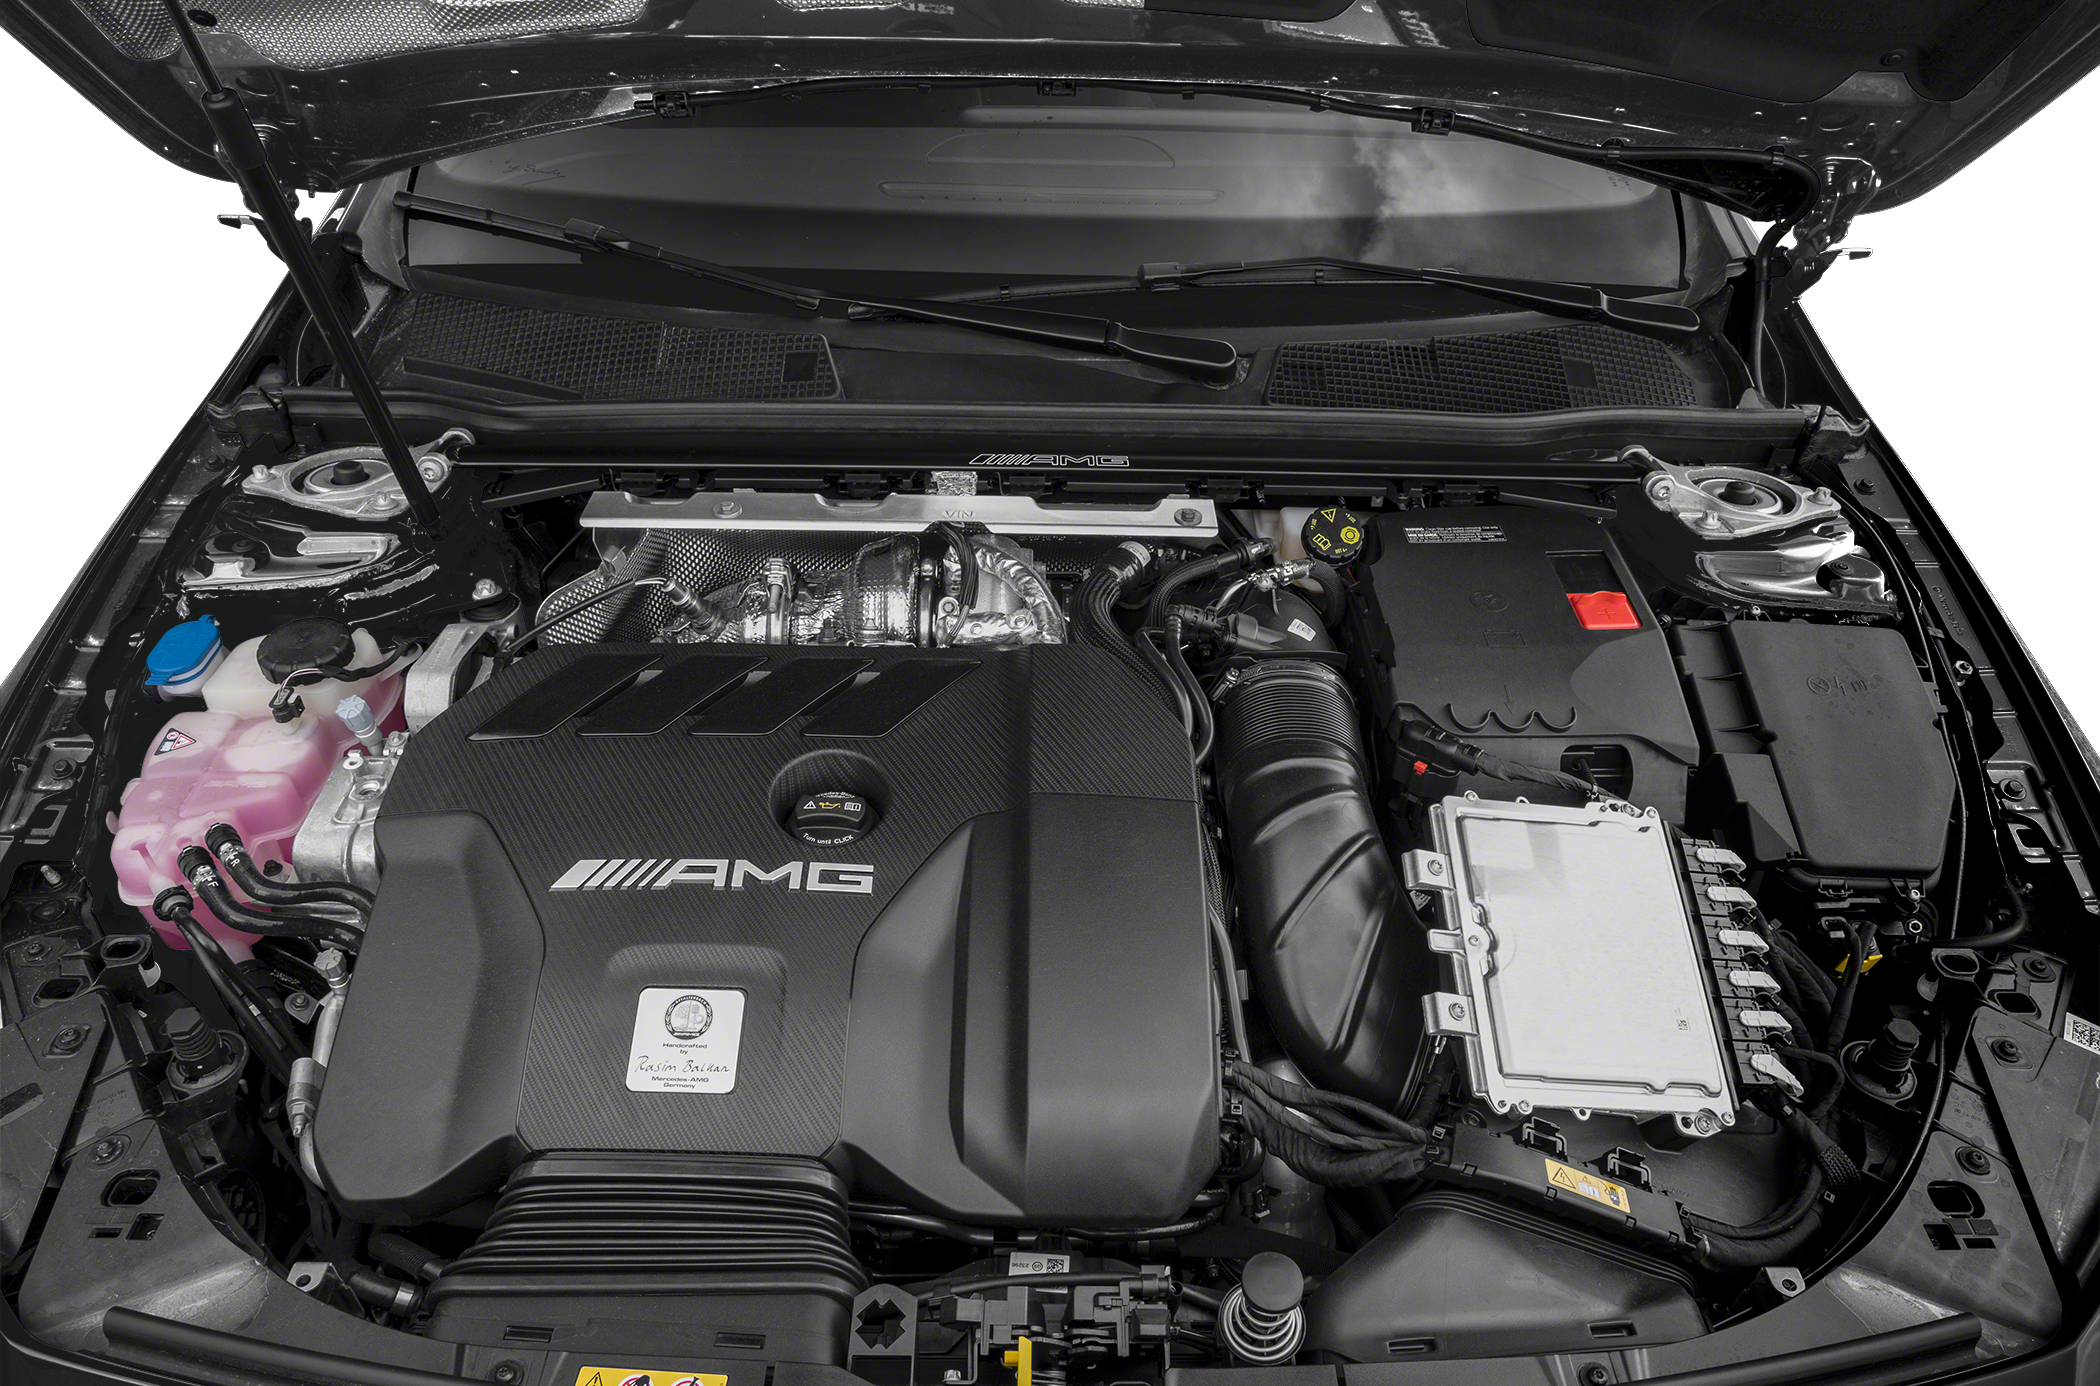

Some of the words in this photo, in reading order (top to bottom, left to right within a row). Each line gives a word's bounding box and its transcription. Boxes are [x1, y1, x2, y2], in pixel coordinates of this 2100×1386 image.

[1024, 454, 1130, 467] AMG
[945, 510, 974, 519] VIN
[803, 832, 816, 843] Turn
[833, 834, 854, 844] CLICK
[650, 859, 875, 896] AMG
